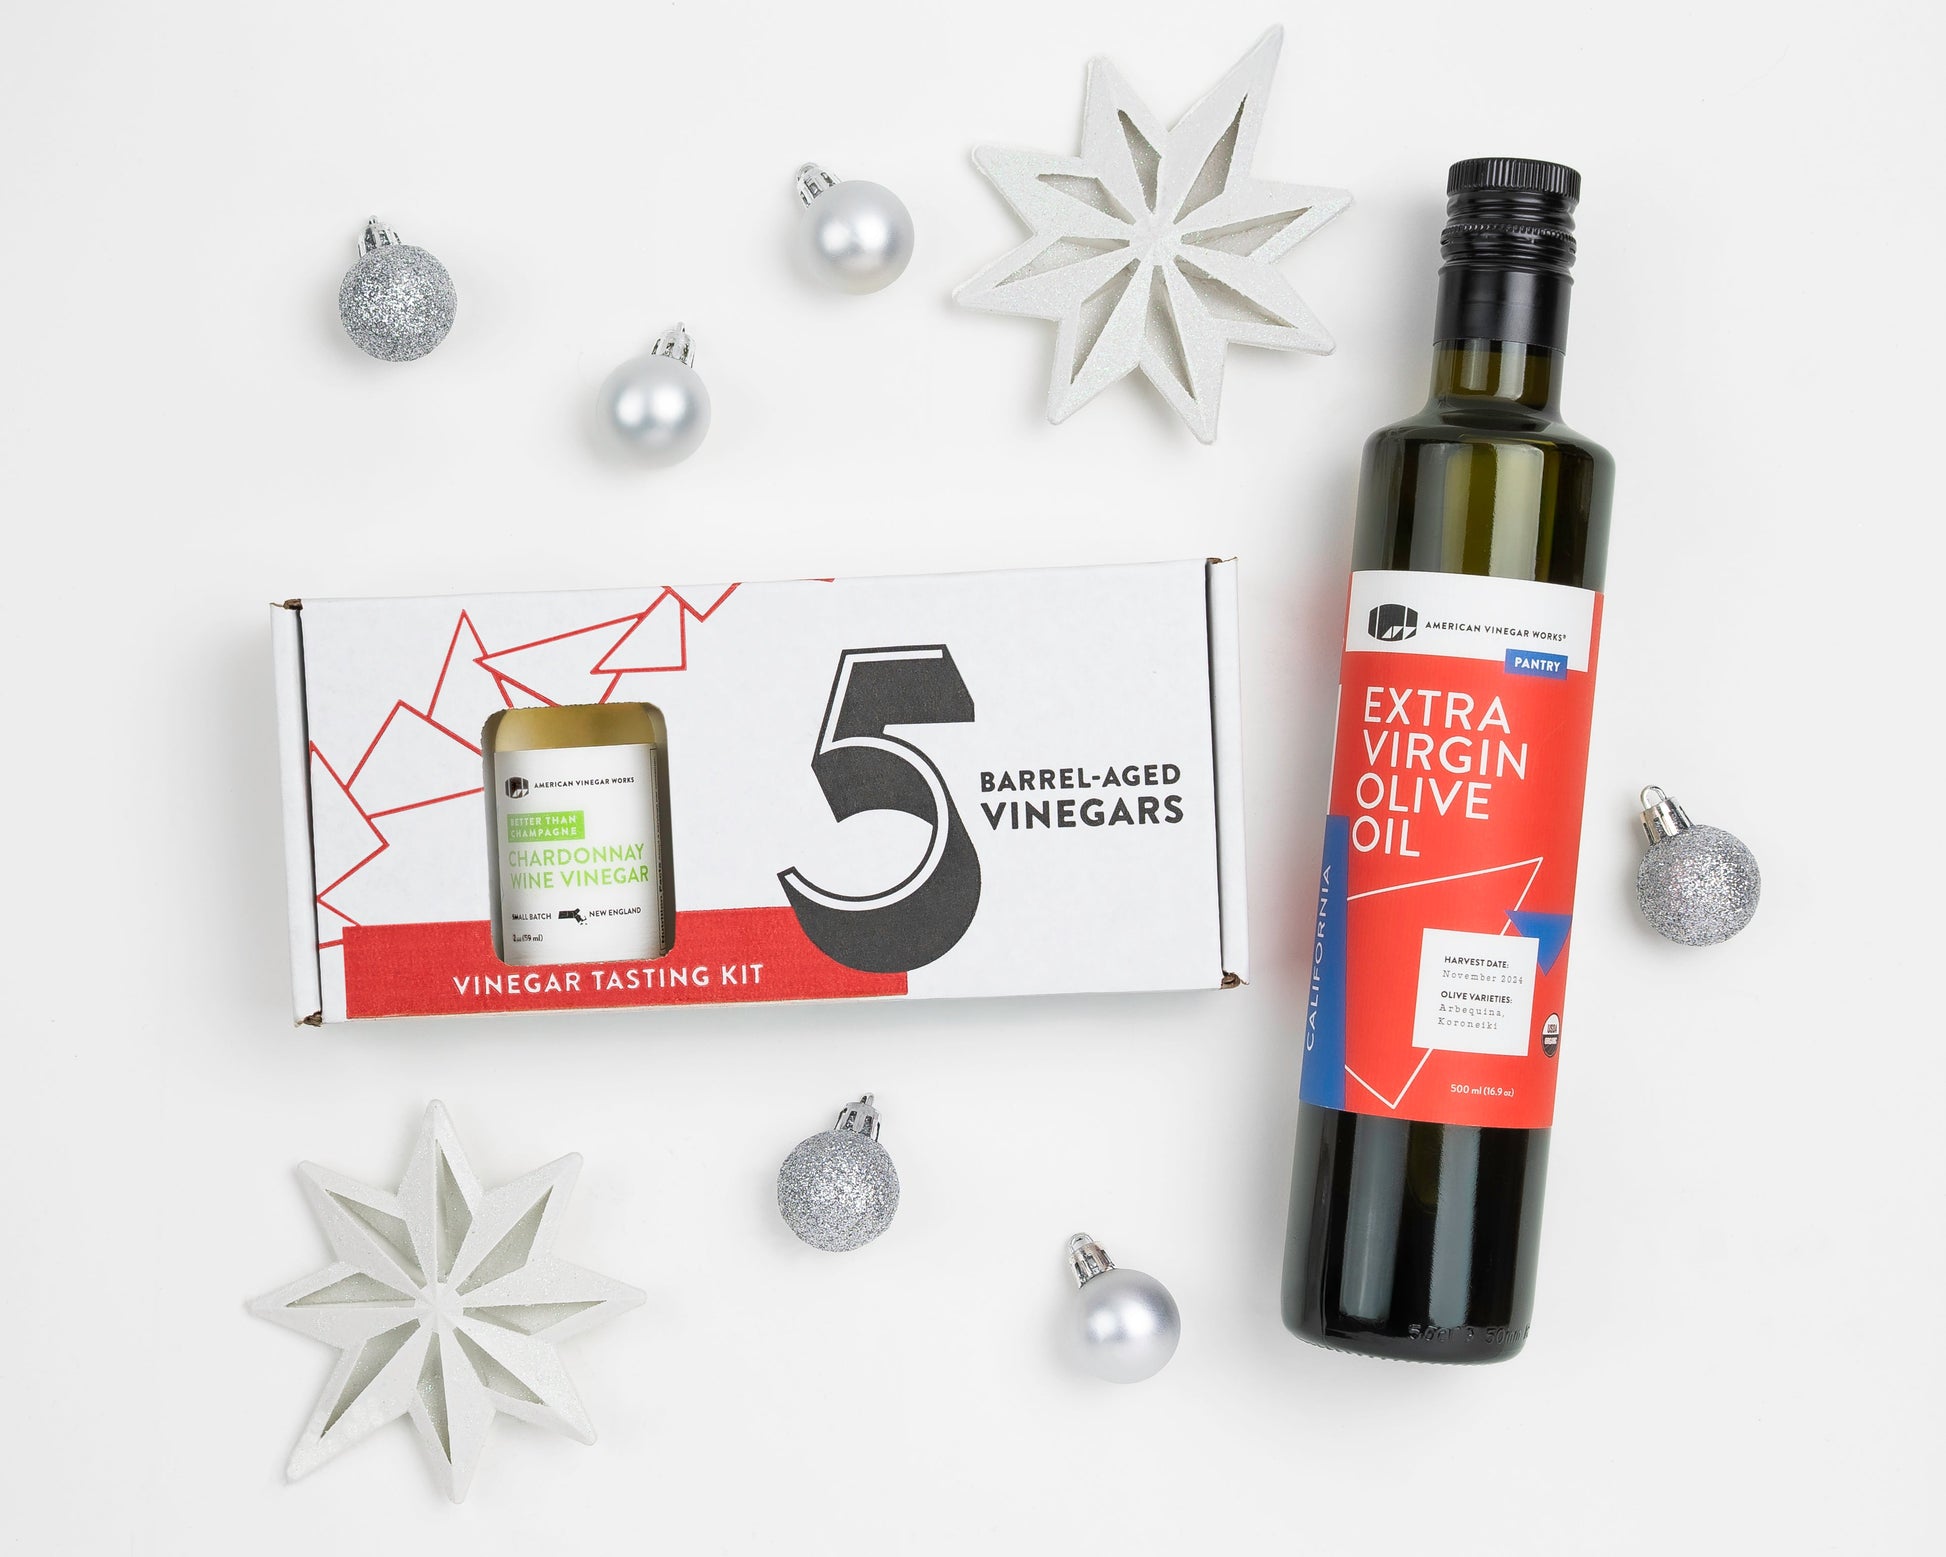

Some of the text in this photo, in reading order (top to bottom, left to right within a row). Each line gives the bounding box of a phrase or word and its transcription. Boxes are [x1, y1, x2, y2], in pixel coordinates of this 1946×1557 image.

[1425, 621, 1481, 633] AMERICAN
[1484, 626, 1529, 638] VINEGAR
[1514, 656, 1561, 673] PANTRY
[1364, 686, 1511, 734] EXTRA
[1363, 729, 1528, 780] VIRGIN
[534, 780, 574, 789] AMERICAN
[575, 778, 610, 786] VINEGAR
[980, 763, 1181, 792] BARREL-AGED
[1356, 772, 1492, 820] OLIVE
[776, 643, 982, 974] 5
[980, 794, 1184, 831] VINEGARS
[510, 815, 577, 827] BETTER THAN
[511, 826, 577, 838] CHAMPAGNE
[1352, 815, 1420, 857] OIL
[508, 843, 645, 868] CHARDONNAY
[510, 865, 649, 889] WINE VINEGAR
[511, 907, 642, 921] SMALL BATCH NEW ENGLAND
[1306, 864, 1332, 1051] CALIFORNIA
[1444, 956, 1509, 969] HARVEST DATE:
[452, 963, 764, 996] VINEGAR TASTING KIT
[1442, 970, 1523, 985] November 2024
[1440, 990, 1513, 1004] OLIVE VARIETIES:
[1438, 1003, 1505, 1018] Arbequina,
[1437, 1017, 1498, 1030] Koroneiki
[1450, 1083, 1515, 1098] 500 ml (16.9 oz)
